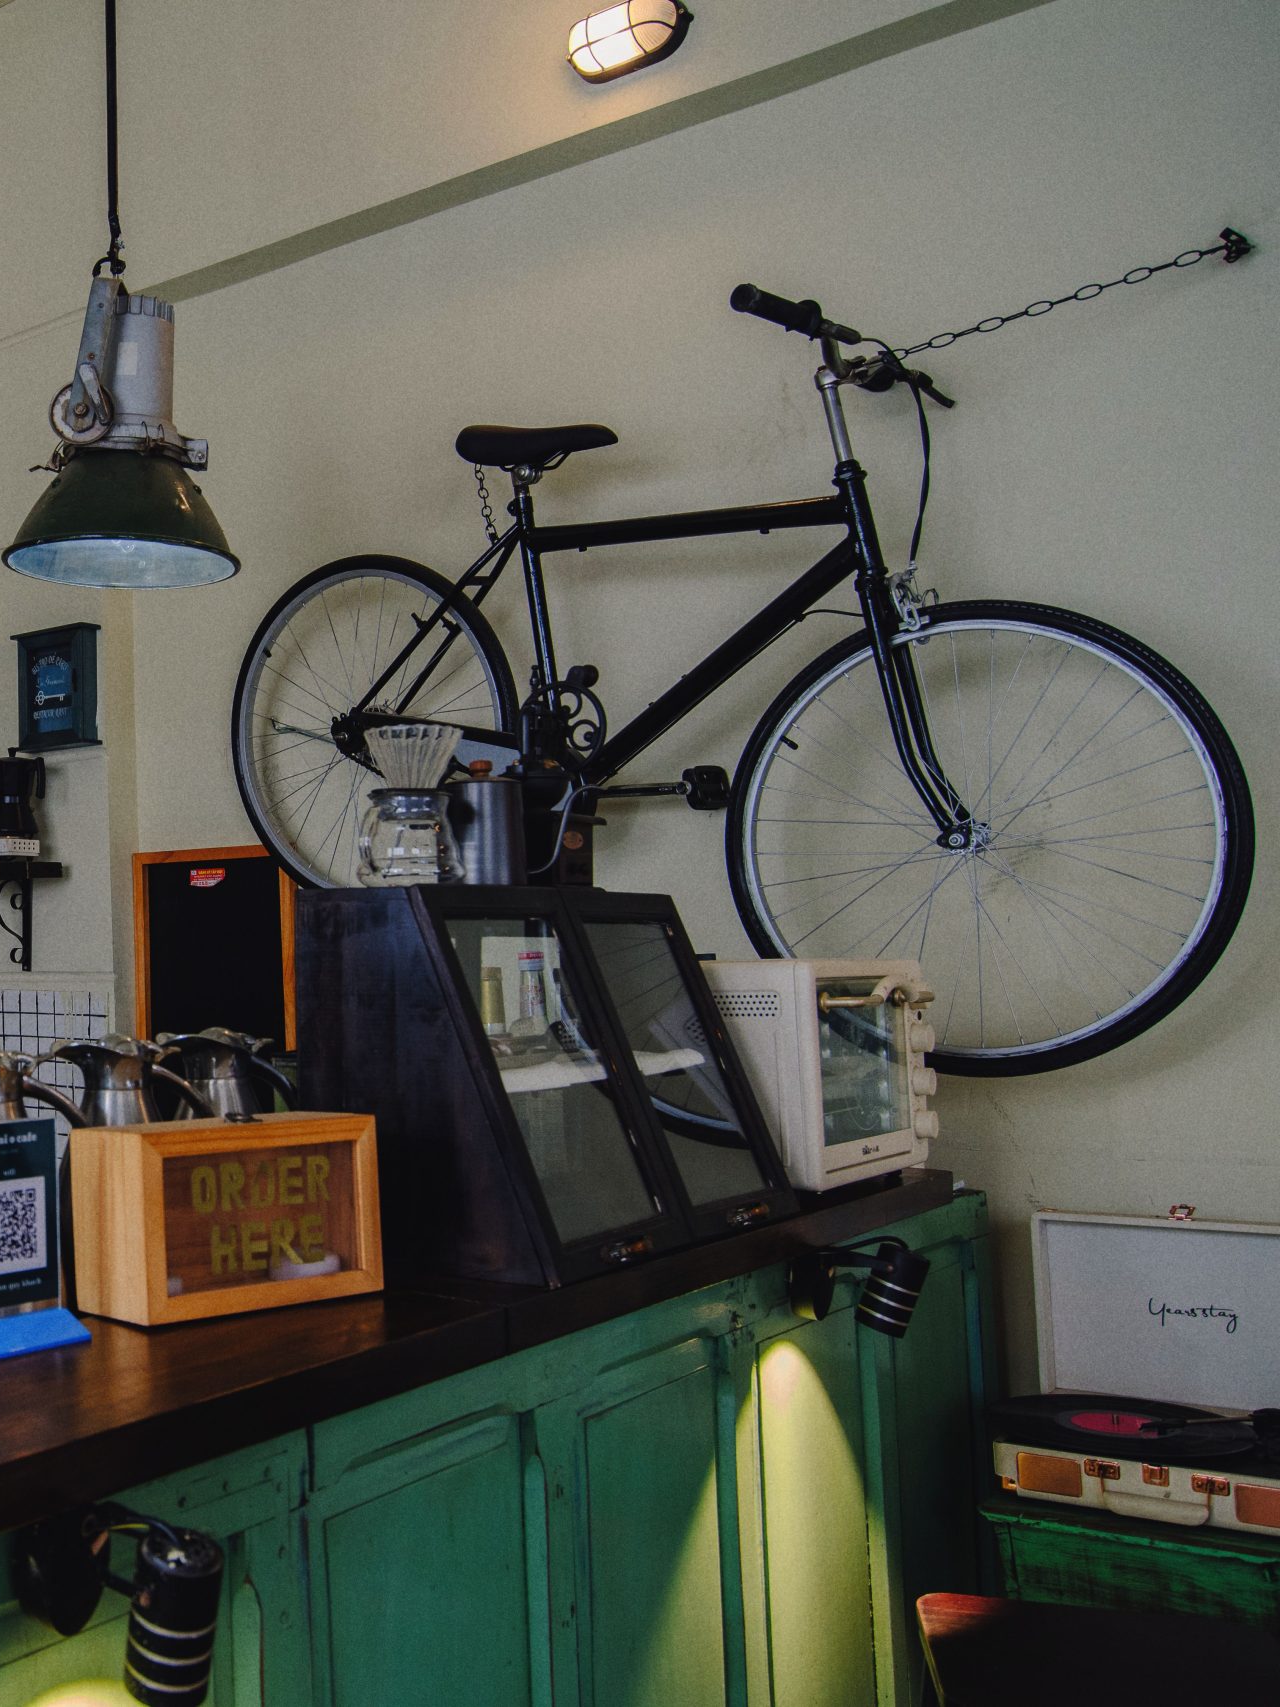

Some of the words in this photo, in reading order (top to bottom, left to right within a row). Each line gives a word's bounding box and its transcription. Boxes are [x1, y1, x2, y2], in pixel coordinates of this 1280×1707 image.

[16, 1131, 38, 1143] cafe
[191, 1154, 330, 1214] ORDER
[211, 1214, 326, 1275] HERE
